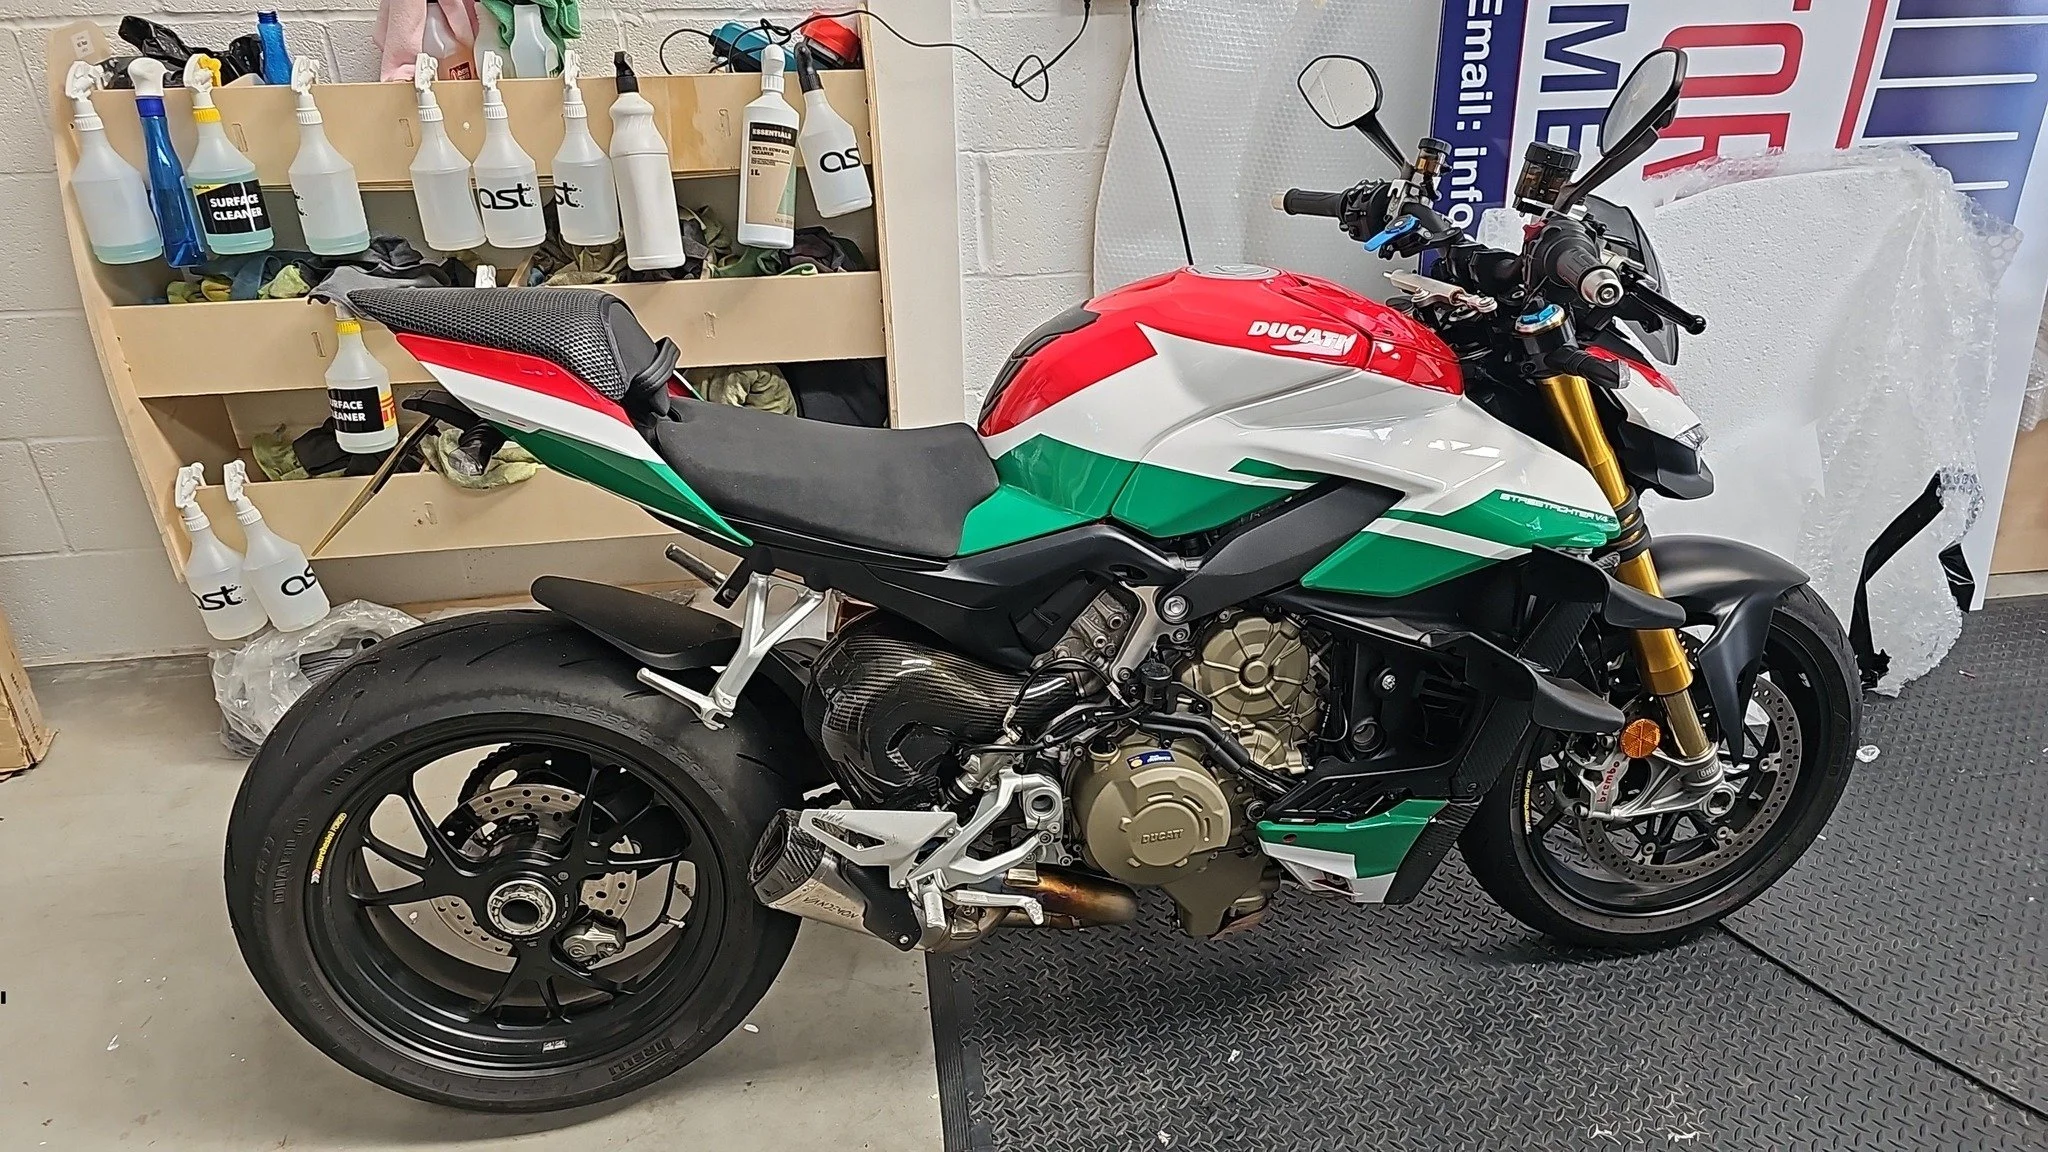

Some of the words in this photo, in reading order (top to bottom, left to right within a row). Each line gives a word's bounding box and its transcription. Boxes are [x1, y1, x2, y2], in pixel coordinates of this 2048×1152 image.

[1454, 0, 1503, 131] Email:
[752, 128, 792, 140] ESSENTIALS
[819, 147, 861, 173] as
[209, 193, 259, 208] SURFACE
[554, 182, 584, 208] st
[213, 206, 263, 221] CLEANER
[1247, 320, 1345, 350] DUCATI
[1500, 493, 1595, 520] STREETFIGHTER
[1597, 761, 1620, 802] brembo
[1141, 828, 1184, 844] DUCATI
